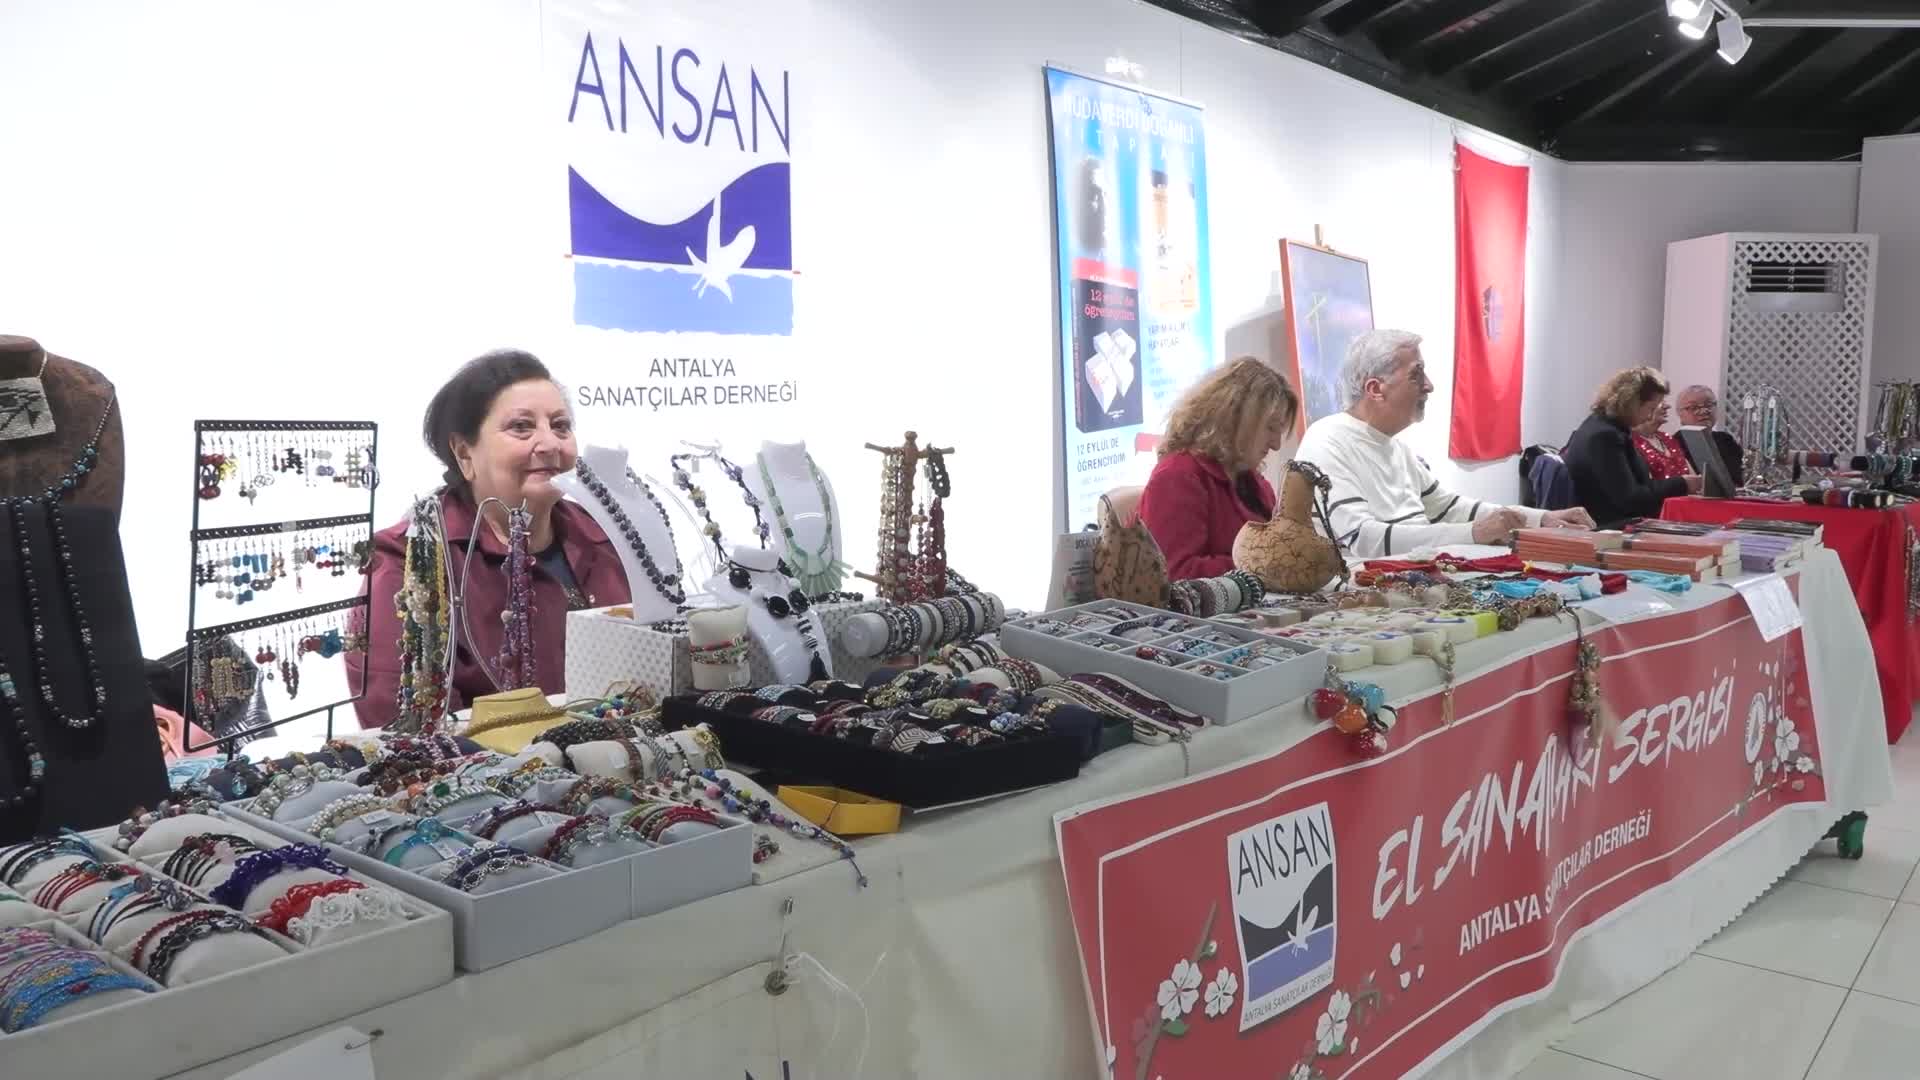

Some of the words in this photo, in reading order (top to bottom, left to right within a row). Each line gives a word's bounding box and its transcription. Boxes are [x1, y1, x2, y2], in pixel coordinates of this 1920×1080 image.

[567, 30, 791, 157] ANSAN
[578, 385, 708, 412] SANATÇILAR
[714, 380, 798, 403] DERNEĞİ
[649, 358, 737, 378] ANTALYA
[1076, 444, 1085, 457] 12
[1372, 814, 1425, 920] EL
[1608, 659, 1737, 784] SERGİSİ
[1237, 809, 1332, 896] ANSAN
[1458, 890, 1542, 956] ANTALYA
[1594, 808, 1653, 860] DERNEĞİ
